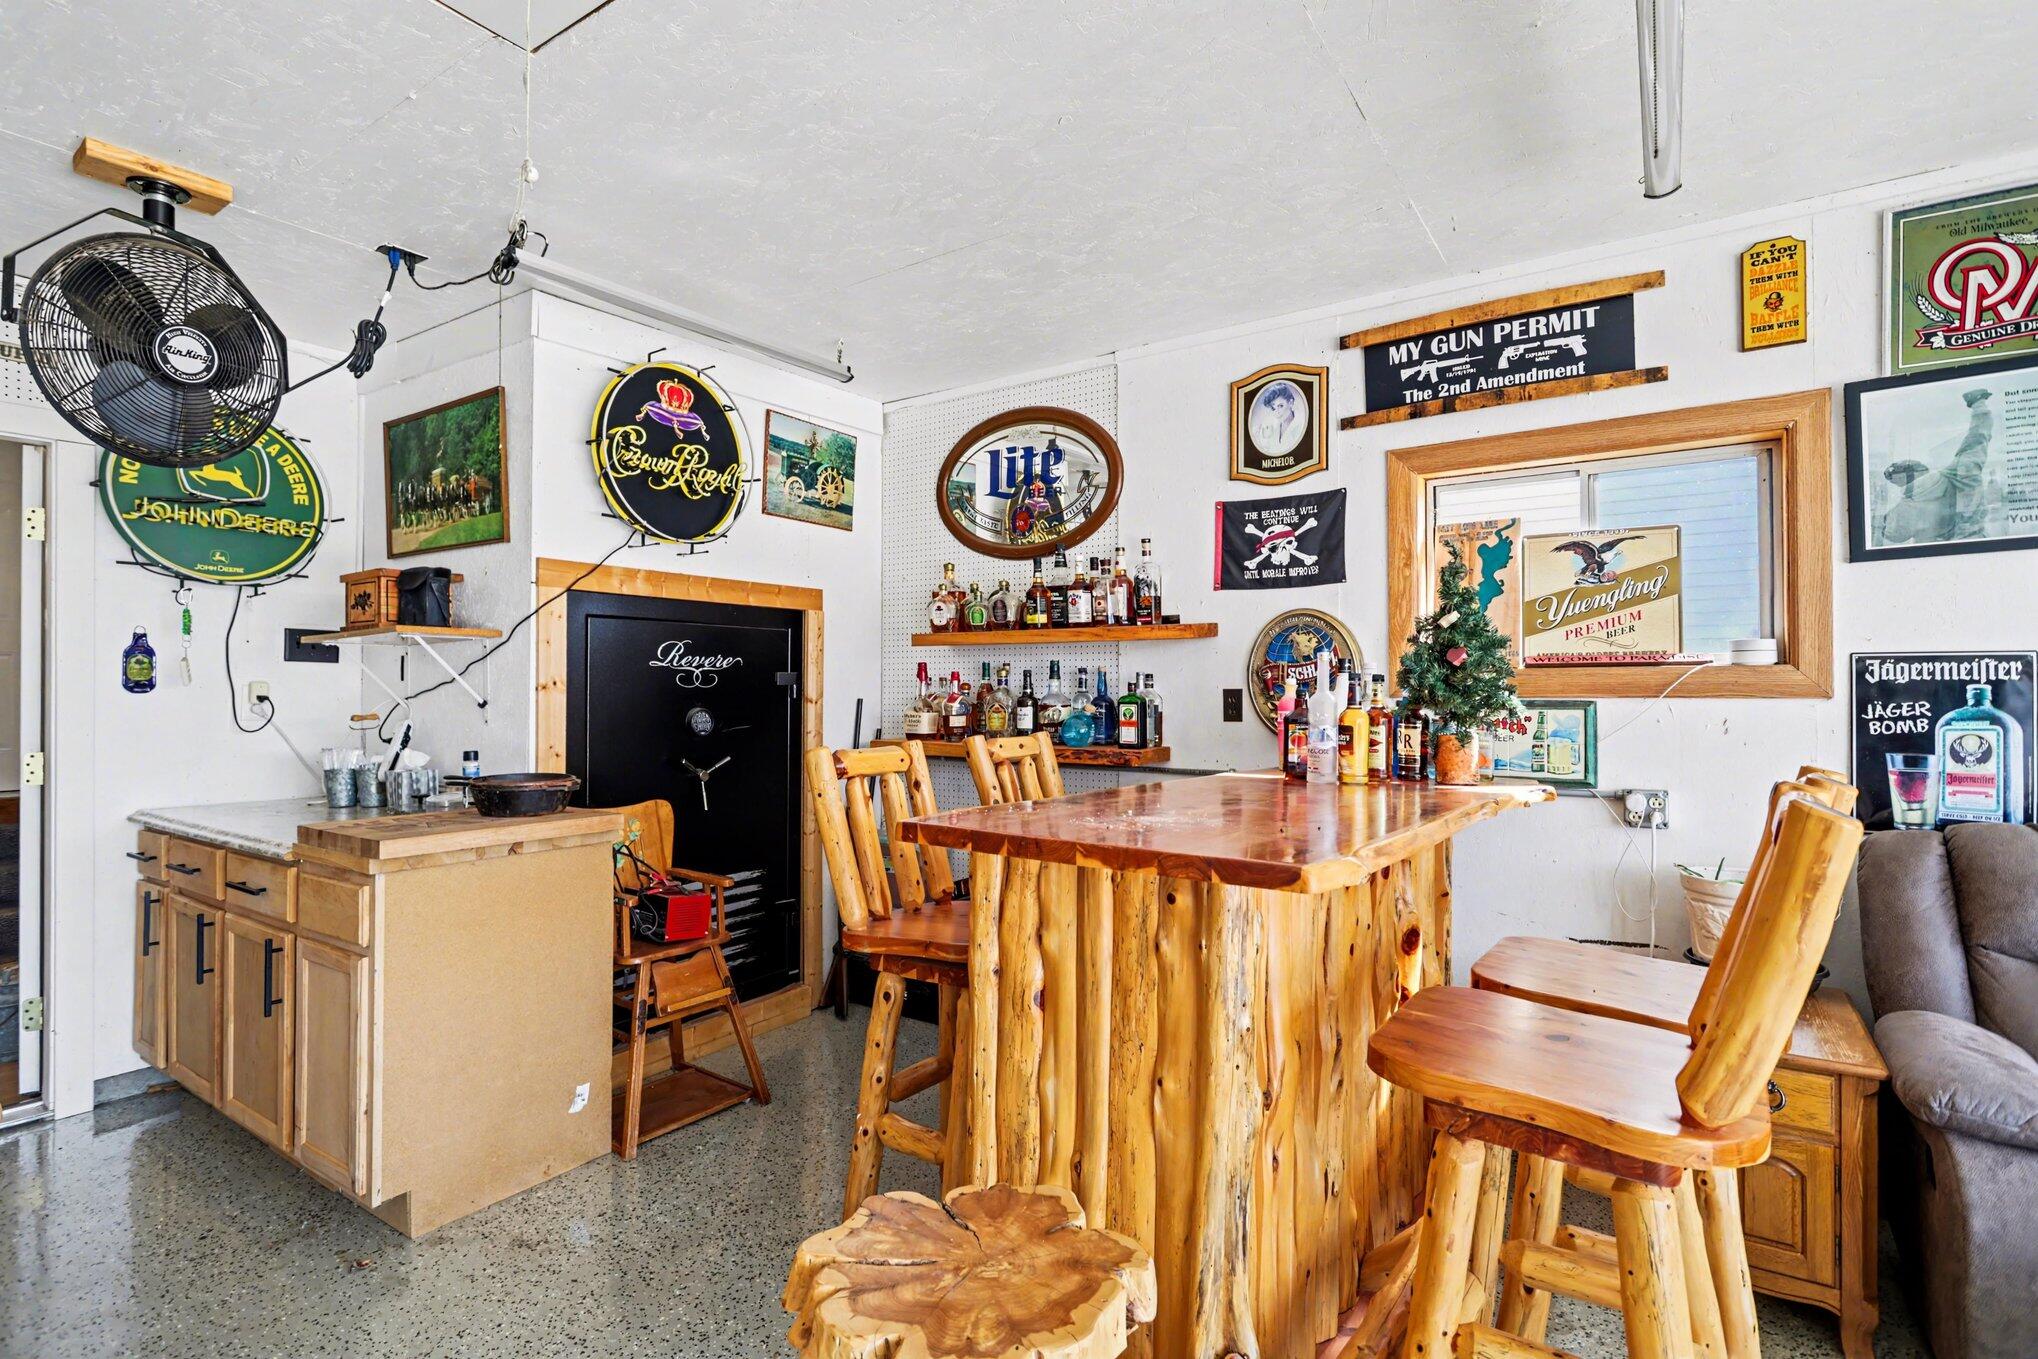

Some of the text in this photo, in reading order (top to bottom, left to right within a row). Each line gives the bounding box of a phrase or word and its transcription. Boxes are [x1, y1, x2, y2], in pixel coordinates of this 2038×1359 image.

[1949, 217, 2028, 238] Old Milwaukee
[1750, 244, 1798, 260] IF YOU
[1750, 252, 1797, 267] CAN'T
[1749, 270, 1798, 285] THEM WITH
[1388, 305, 1600, 366] MY GUN PERMIT
[1750, 319, 1800, 334] THEM WITH
[1950, 324, 2016, 346] GENUINE
[1403, 360, 1586, 405] The 2nd Amendment
[599, 425, 680, 479] Crown
[1261, 455, 1296, 469] MICHELOB
[267, 444, 310, 507] A DEERE
[650, 443, 748, 501] Royal
[983, 445, 1067, 500] Lite
[1243, 511, 1259, 520] THE
[1299, 505, 1318, 515] WILL
[1263, 515, 1300, 525] CONTINUE
[193, 563, 246, 574] JOHN DEERE
[1243, 569, 1260, 580] UNTIL
[1262, 567, 1287, 579] MORALE
[1535, 564, 1670, 631] Yuengling
[1564, 609, 1643, 641] PREMIUM
[1606, 624, 1636, 639] BEER
[649, 639, 743, 671] Revere
[1532, 655, 1602, 663] WELCOME
[1861, 700, 1932, 720] JÄGER
[1868, 717, 1930, 735] BOMB
